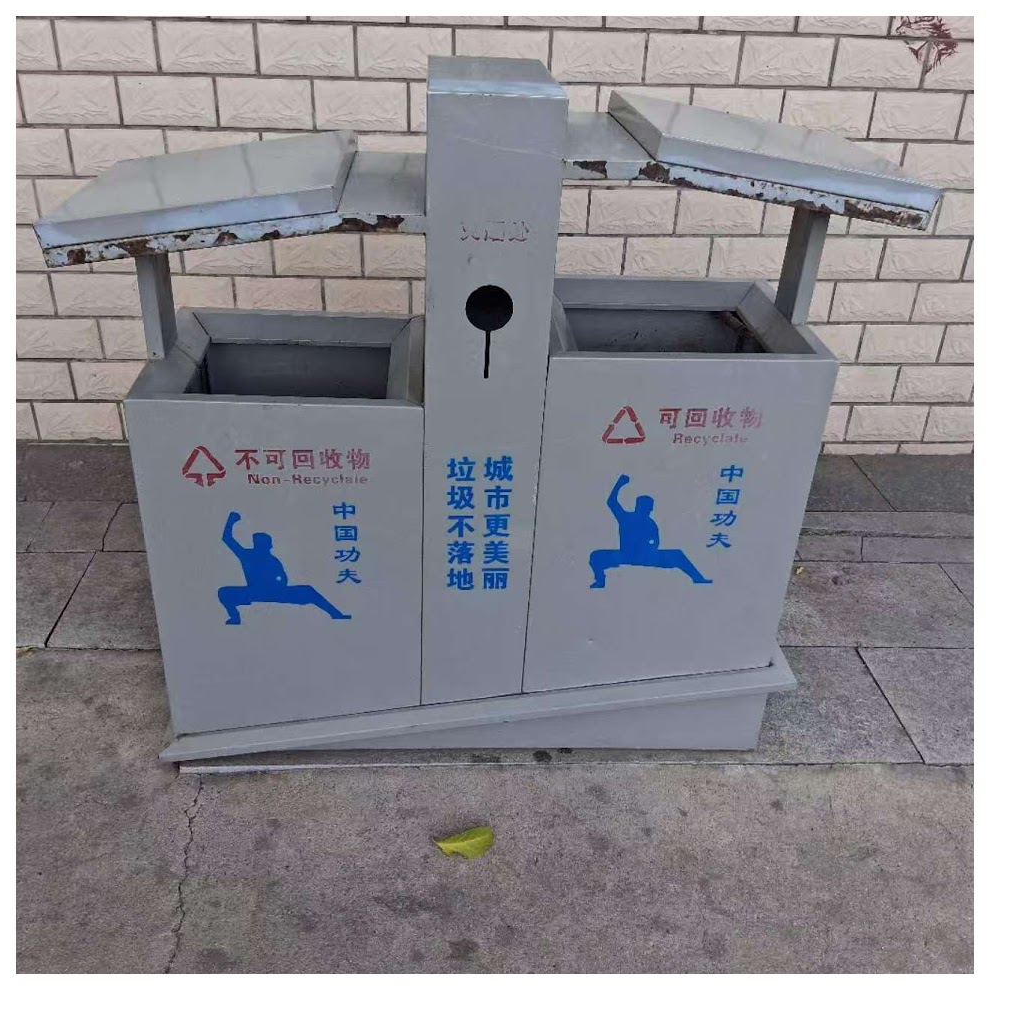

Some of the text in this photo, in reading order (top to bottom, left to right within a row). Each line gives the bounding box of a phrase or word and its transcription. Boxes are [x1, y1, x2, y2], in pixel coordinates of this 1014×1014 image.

[234, 448, 371, 470] 不可回收物
[659, 407, 763, 429] 可回收物
[332, 501, 362, 584] 中国功夫
[447, 456, 476, 591] 垃圾不落地
[482, 455, 513, 590] 城市更美丽
[706, 464, 744, 548] 中国功夫
